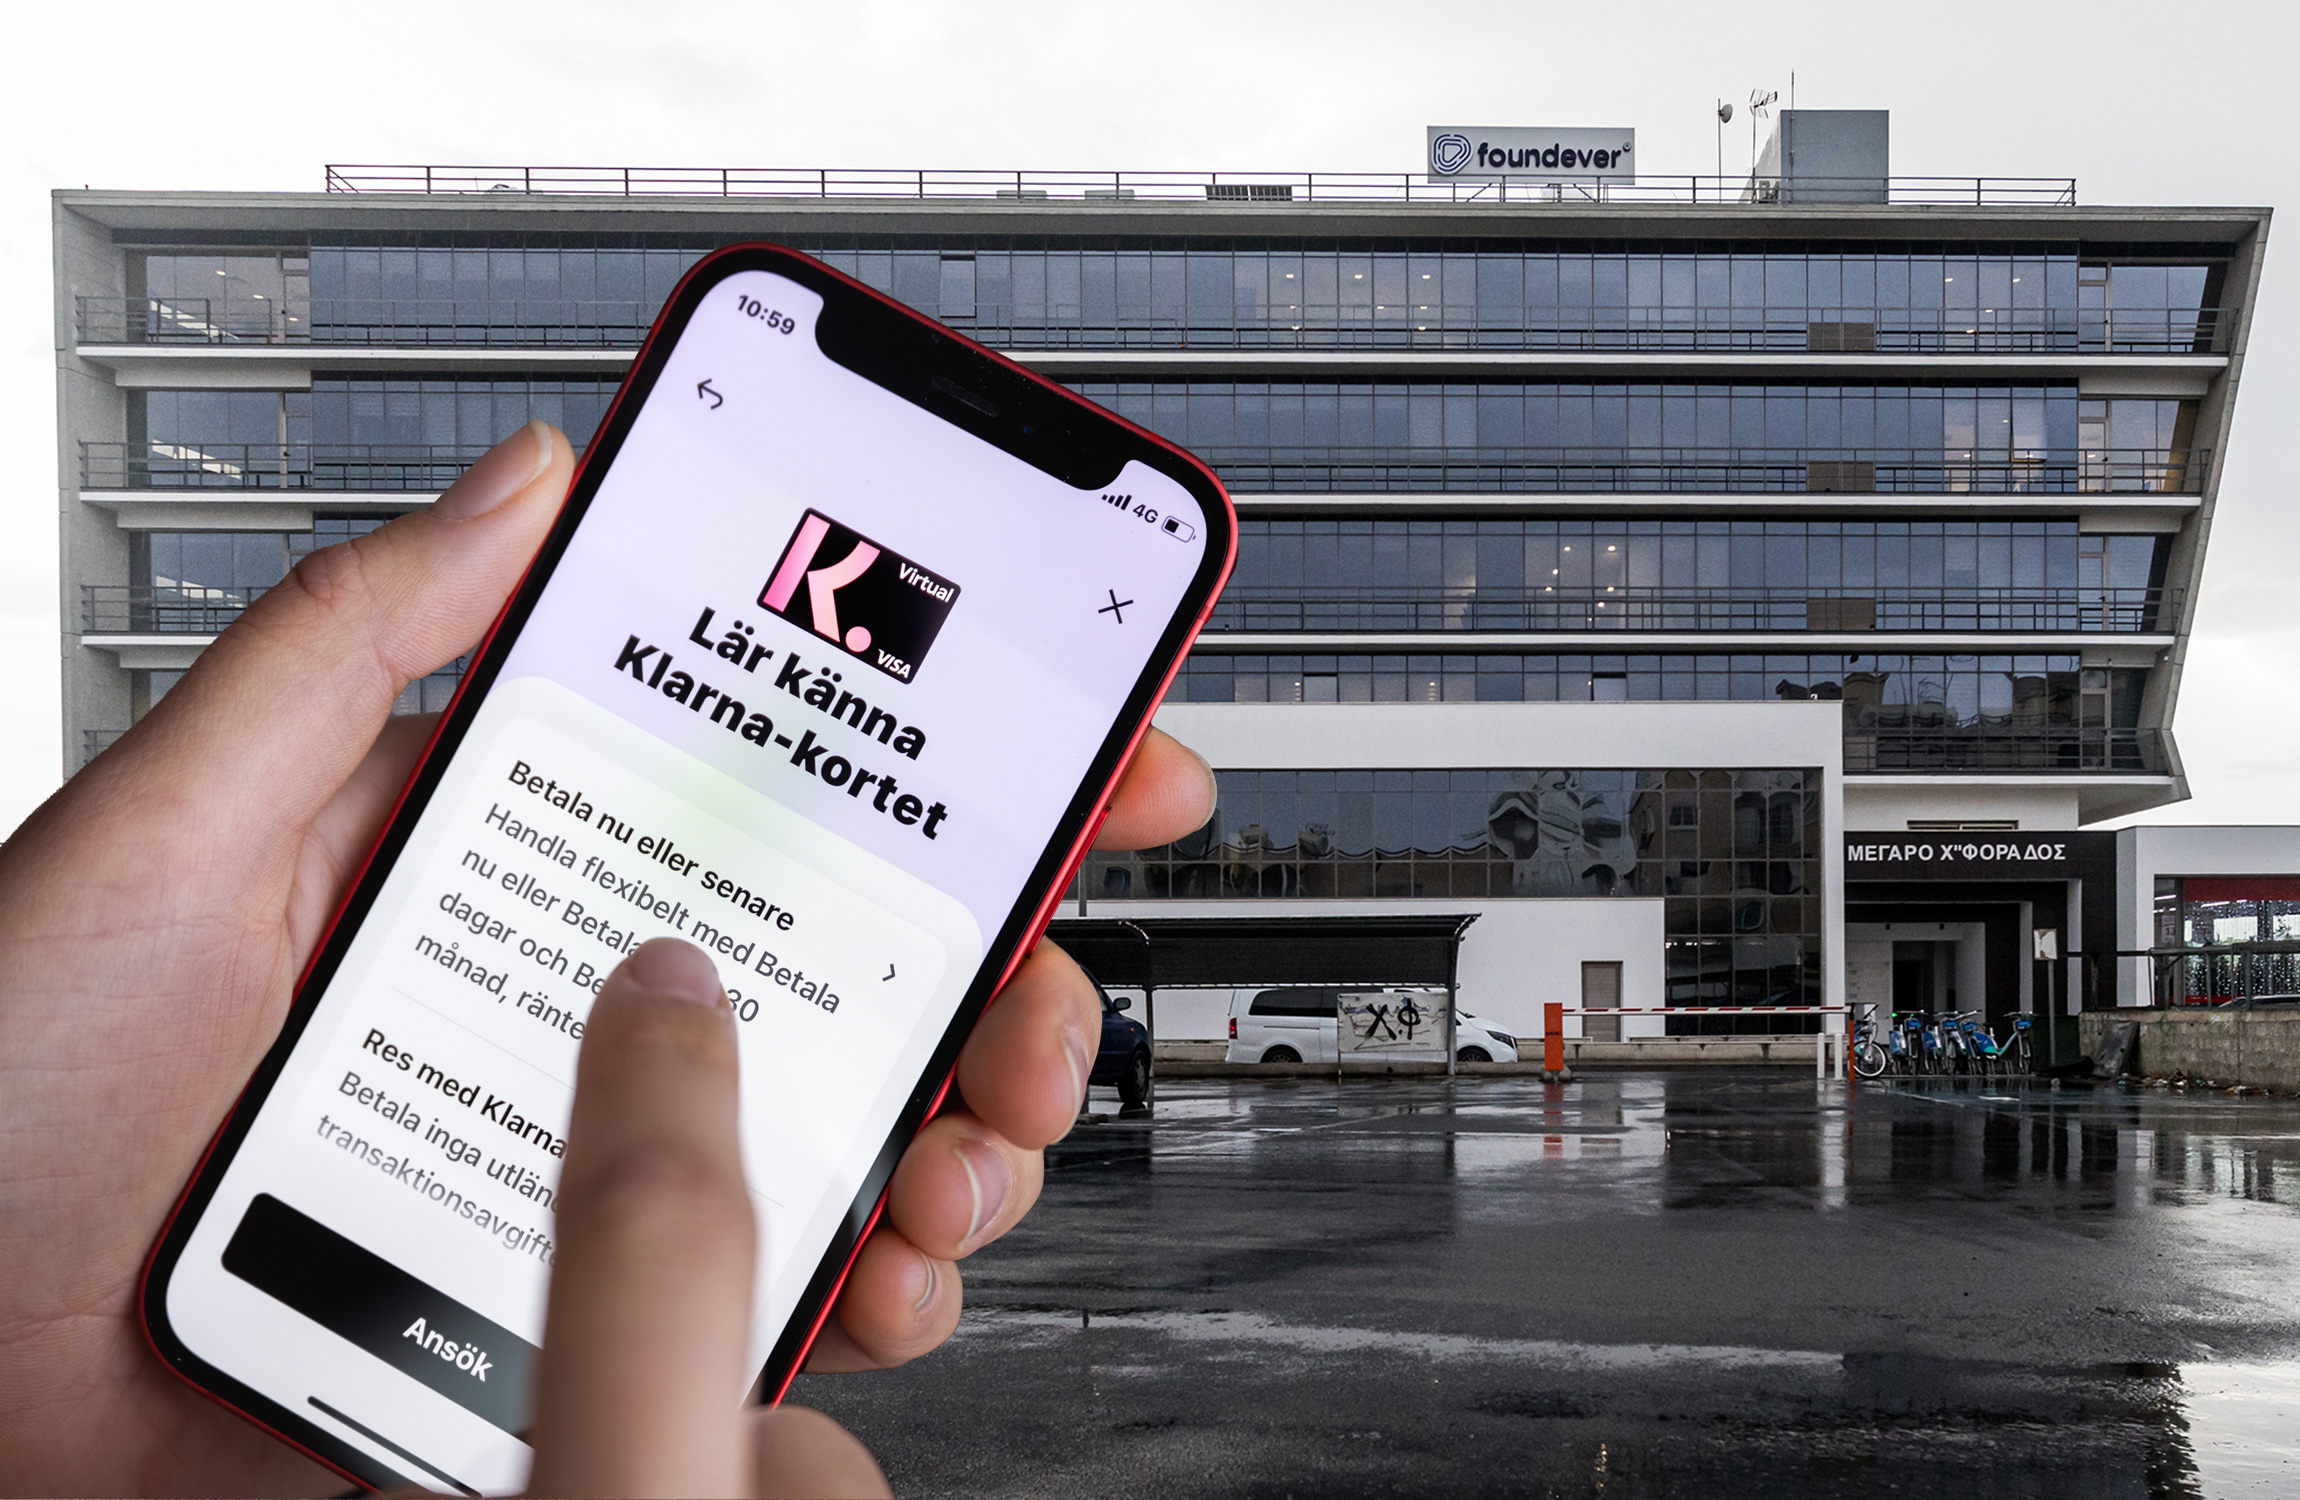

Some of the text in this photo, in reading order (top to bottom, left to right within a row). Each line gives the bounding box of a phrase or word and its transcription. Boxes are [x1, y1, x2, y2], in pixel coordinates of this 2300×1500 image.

[1478, 142, 1621, 169] foundever
[736, 294, 795, 335] 10:59
[1133, 504, 1158, 523] 4G
[899, 562, 954, 603] Virtual
[689, 606, 926, 761] Lär känna
[877, 649, 911, 678] VISA
[613, 634, 948, 840] Klarna-kortet
[462, 846, 498, 880] nu
[501, 873, 561, 911] eller
[508, 760, 794, 931] Betala nu eller senare
[1848, 845, 1934, 861] ΜΕΓΑΡΟ
[439, 892, 517, 943] dagar
[519, 938, 568, 975] och
[484, 803, 841, 1014] Handla flexibelt med Betala
[415, 935, 509, 1004] månad,
[338, 1071, 421, 1133] Betala
[424, 1118, 482, 1167] inga
[361, 1028, 568, 1160] Res med Klarna
[402, 1316, 494, 1383] Ansök
